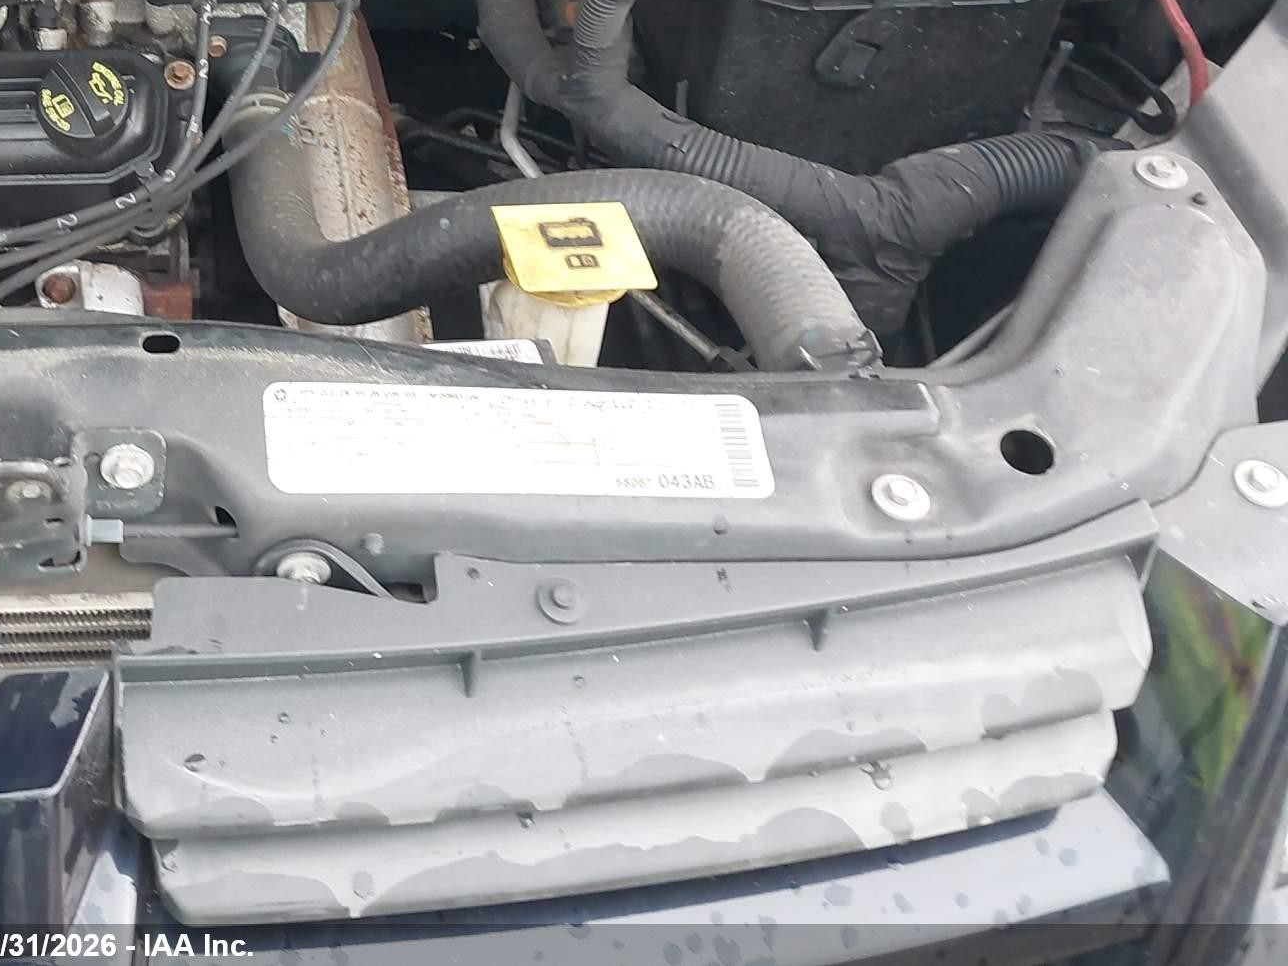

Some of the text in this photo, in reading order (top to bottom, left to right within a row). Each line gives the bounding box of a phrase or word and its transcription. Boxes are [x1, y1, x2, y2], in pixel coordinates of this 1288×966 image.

[198, 58, 209, 80] 2
[115, 192, 137, 209] 2
[57, 213, 79, 230] 2
[658, 473, 716, 490] 043AB
